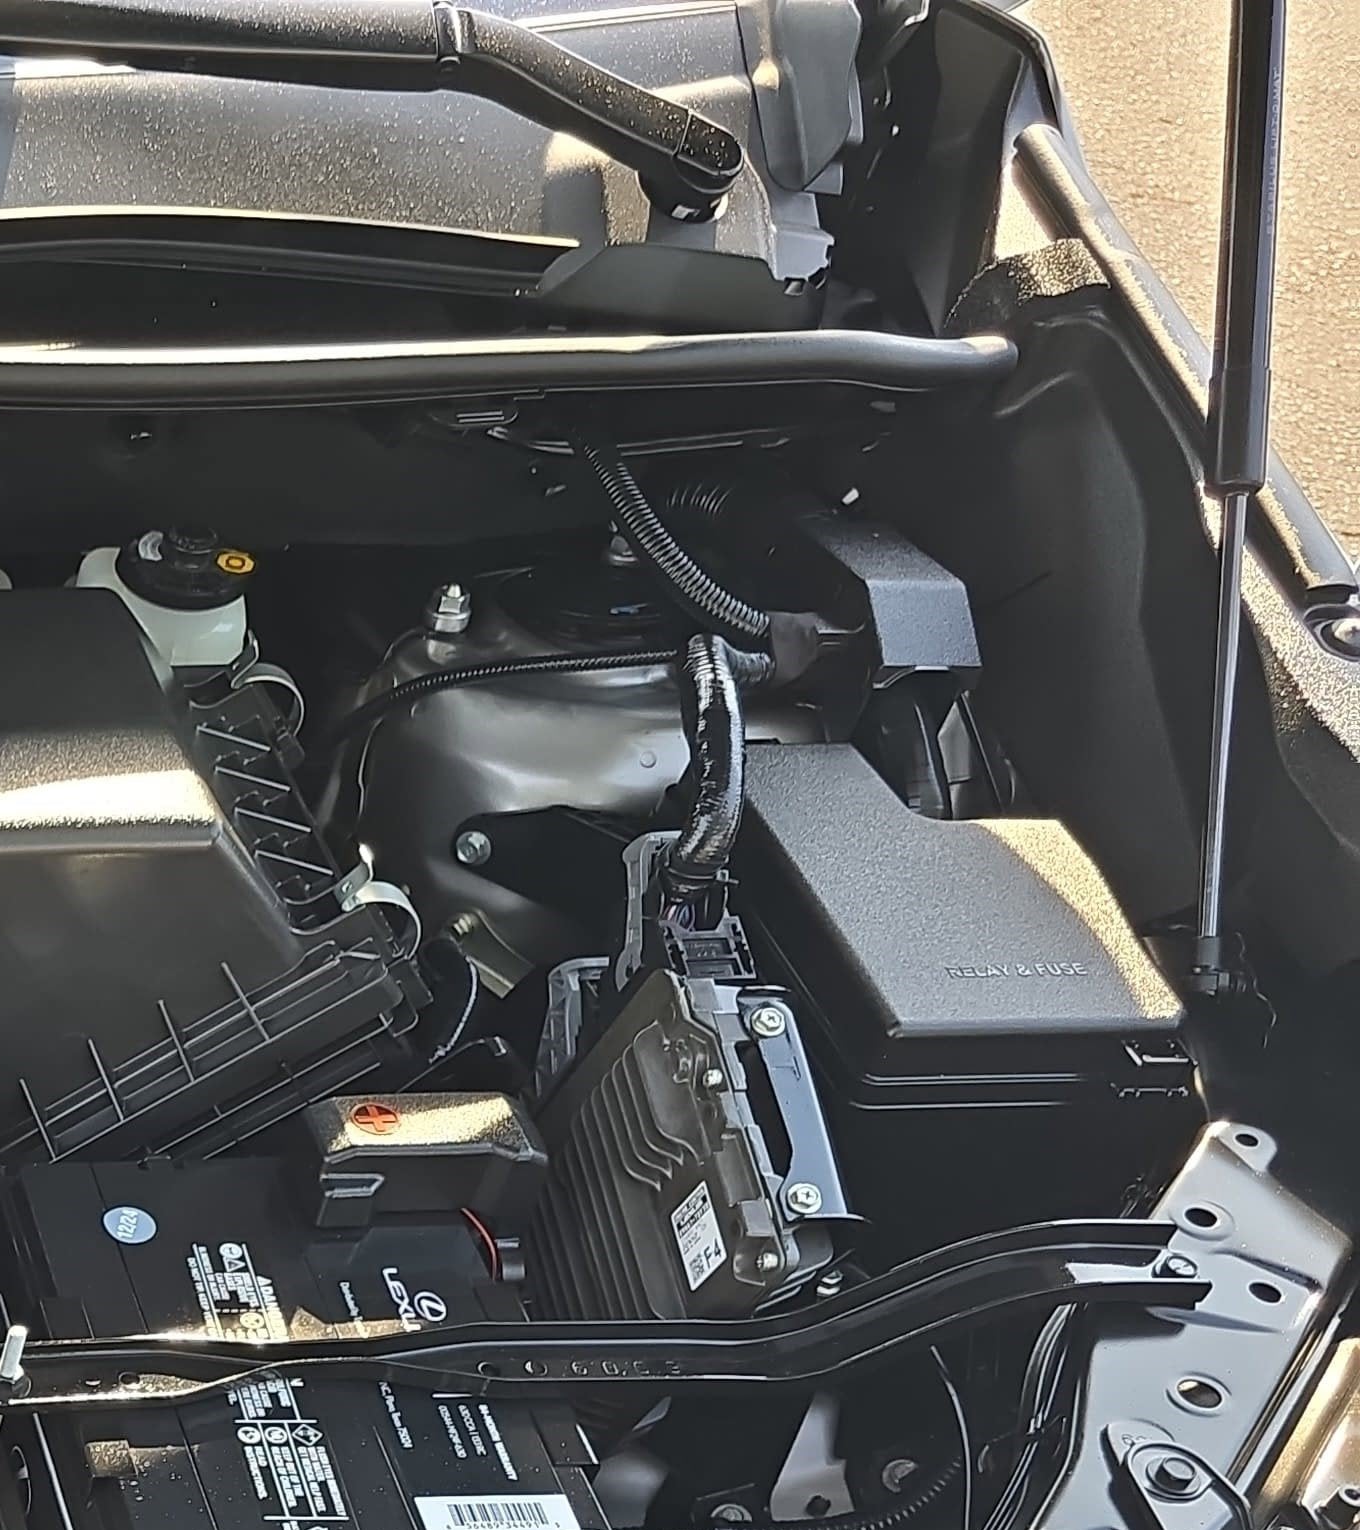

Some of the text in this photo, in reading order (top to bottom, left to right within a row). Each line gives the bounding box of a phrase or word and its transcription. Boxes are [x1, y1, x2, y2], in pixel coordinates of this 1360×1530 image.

[945, 962, 1089, 979] RELAY & FUSE
[117, 1209, 138, 1239] 12/24
[382, 1268, 422, 1332] LEXU
